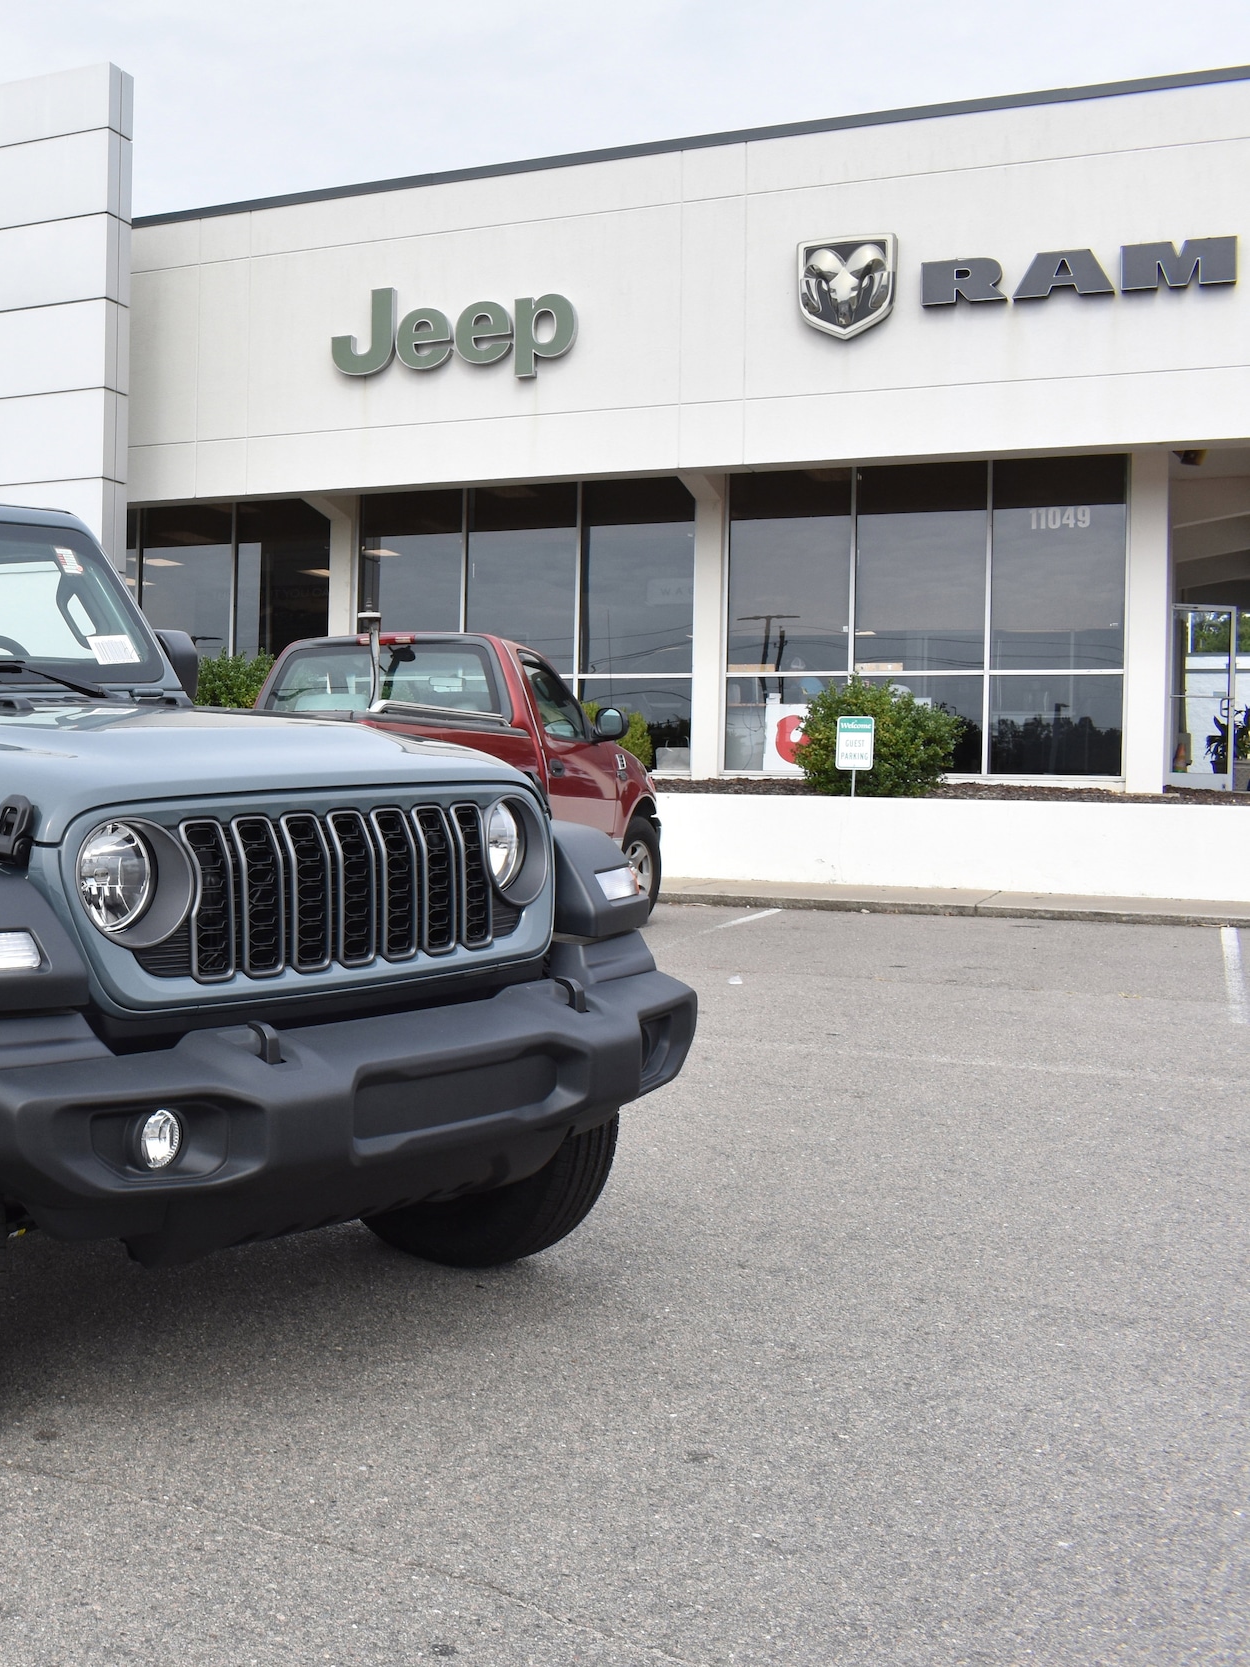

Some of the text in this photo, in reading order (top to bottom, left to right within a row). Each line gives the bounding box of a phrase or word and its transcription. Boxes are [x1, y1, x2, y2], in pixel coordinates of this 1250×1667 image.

[921, 236, 1238, 307] RAM
[331, 287, 579, 379] Jeep
[1030, 506, 1090, 530] 11049
[840, 720, 872, 729] Welcome
[845, 739, 865, 748] GUEST
[841, 752, 868, 760] PARKING
